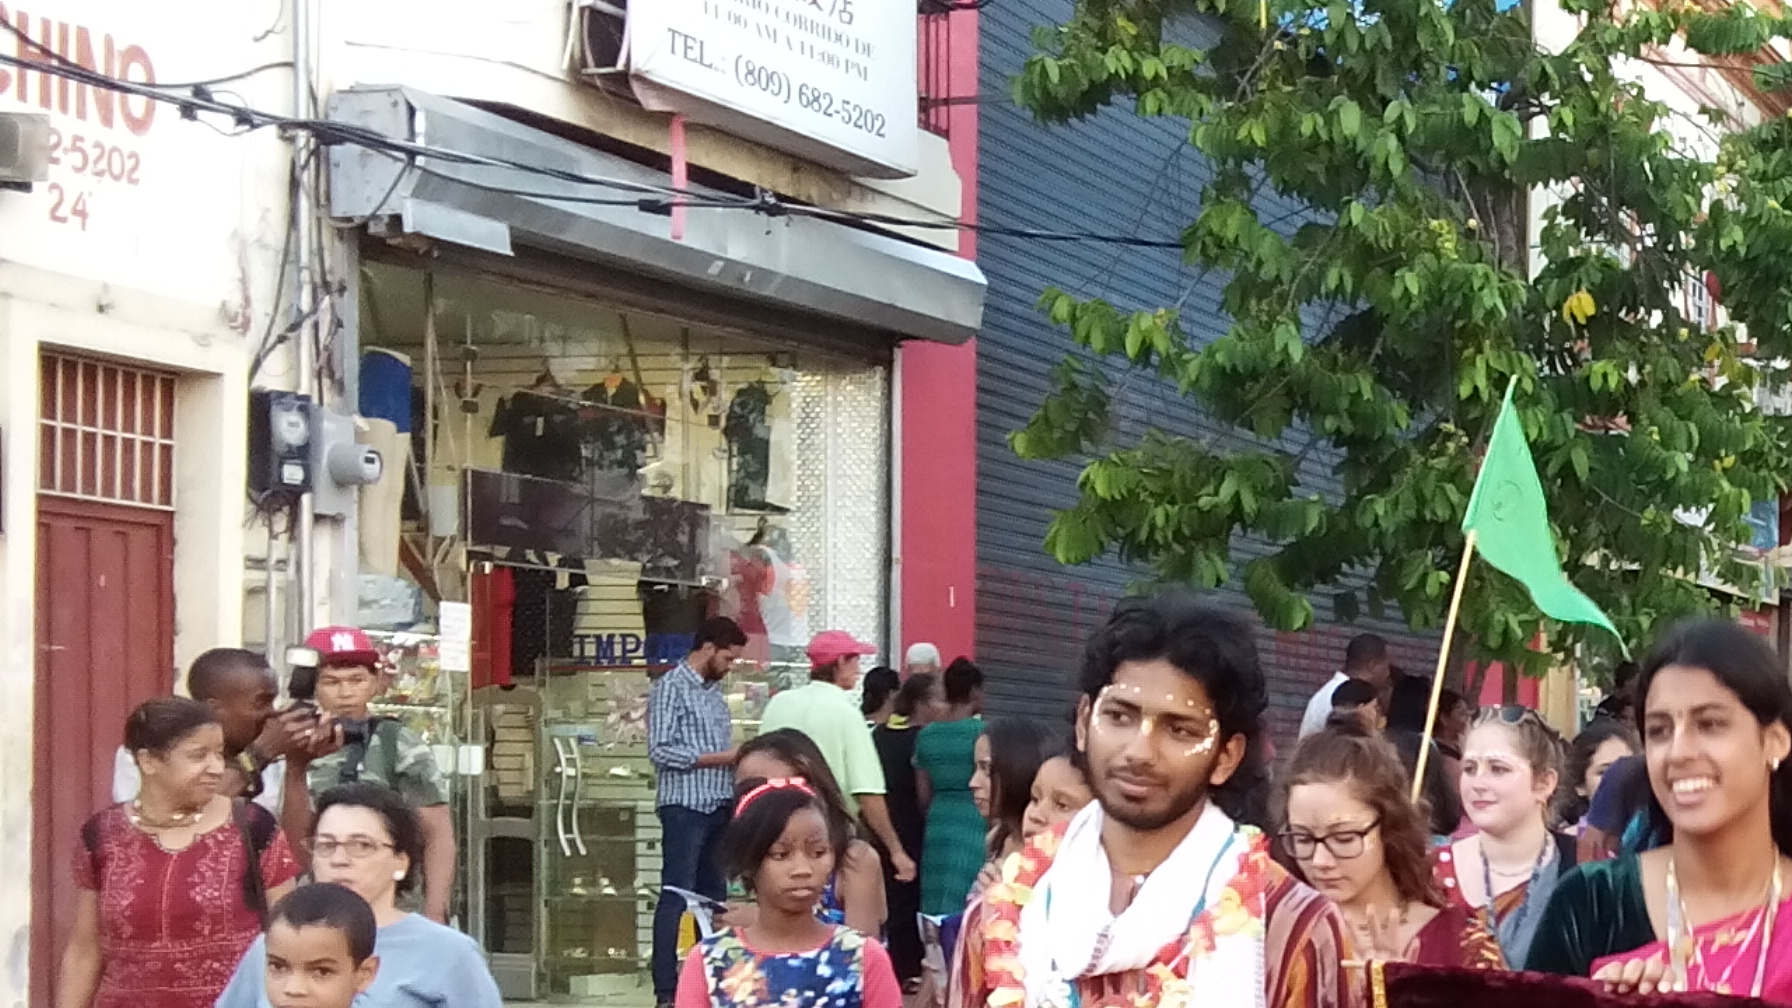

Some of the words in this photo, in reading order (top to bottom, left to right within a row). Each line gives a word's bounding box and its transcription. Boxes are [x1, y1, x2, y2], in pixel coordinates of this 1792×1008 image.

[774, 5, 851, 49] CORRIDO
[734, 54, 792, 104] (809)
[797, 82, 888, 140] 682-5202
[49, 128, 140, 185] 2-5202
[49, 183, 89, 231] 24
